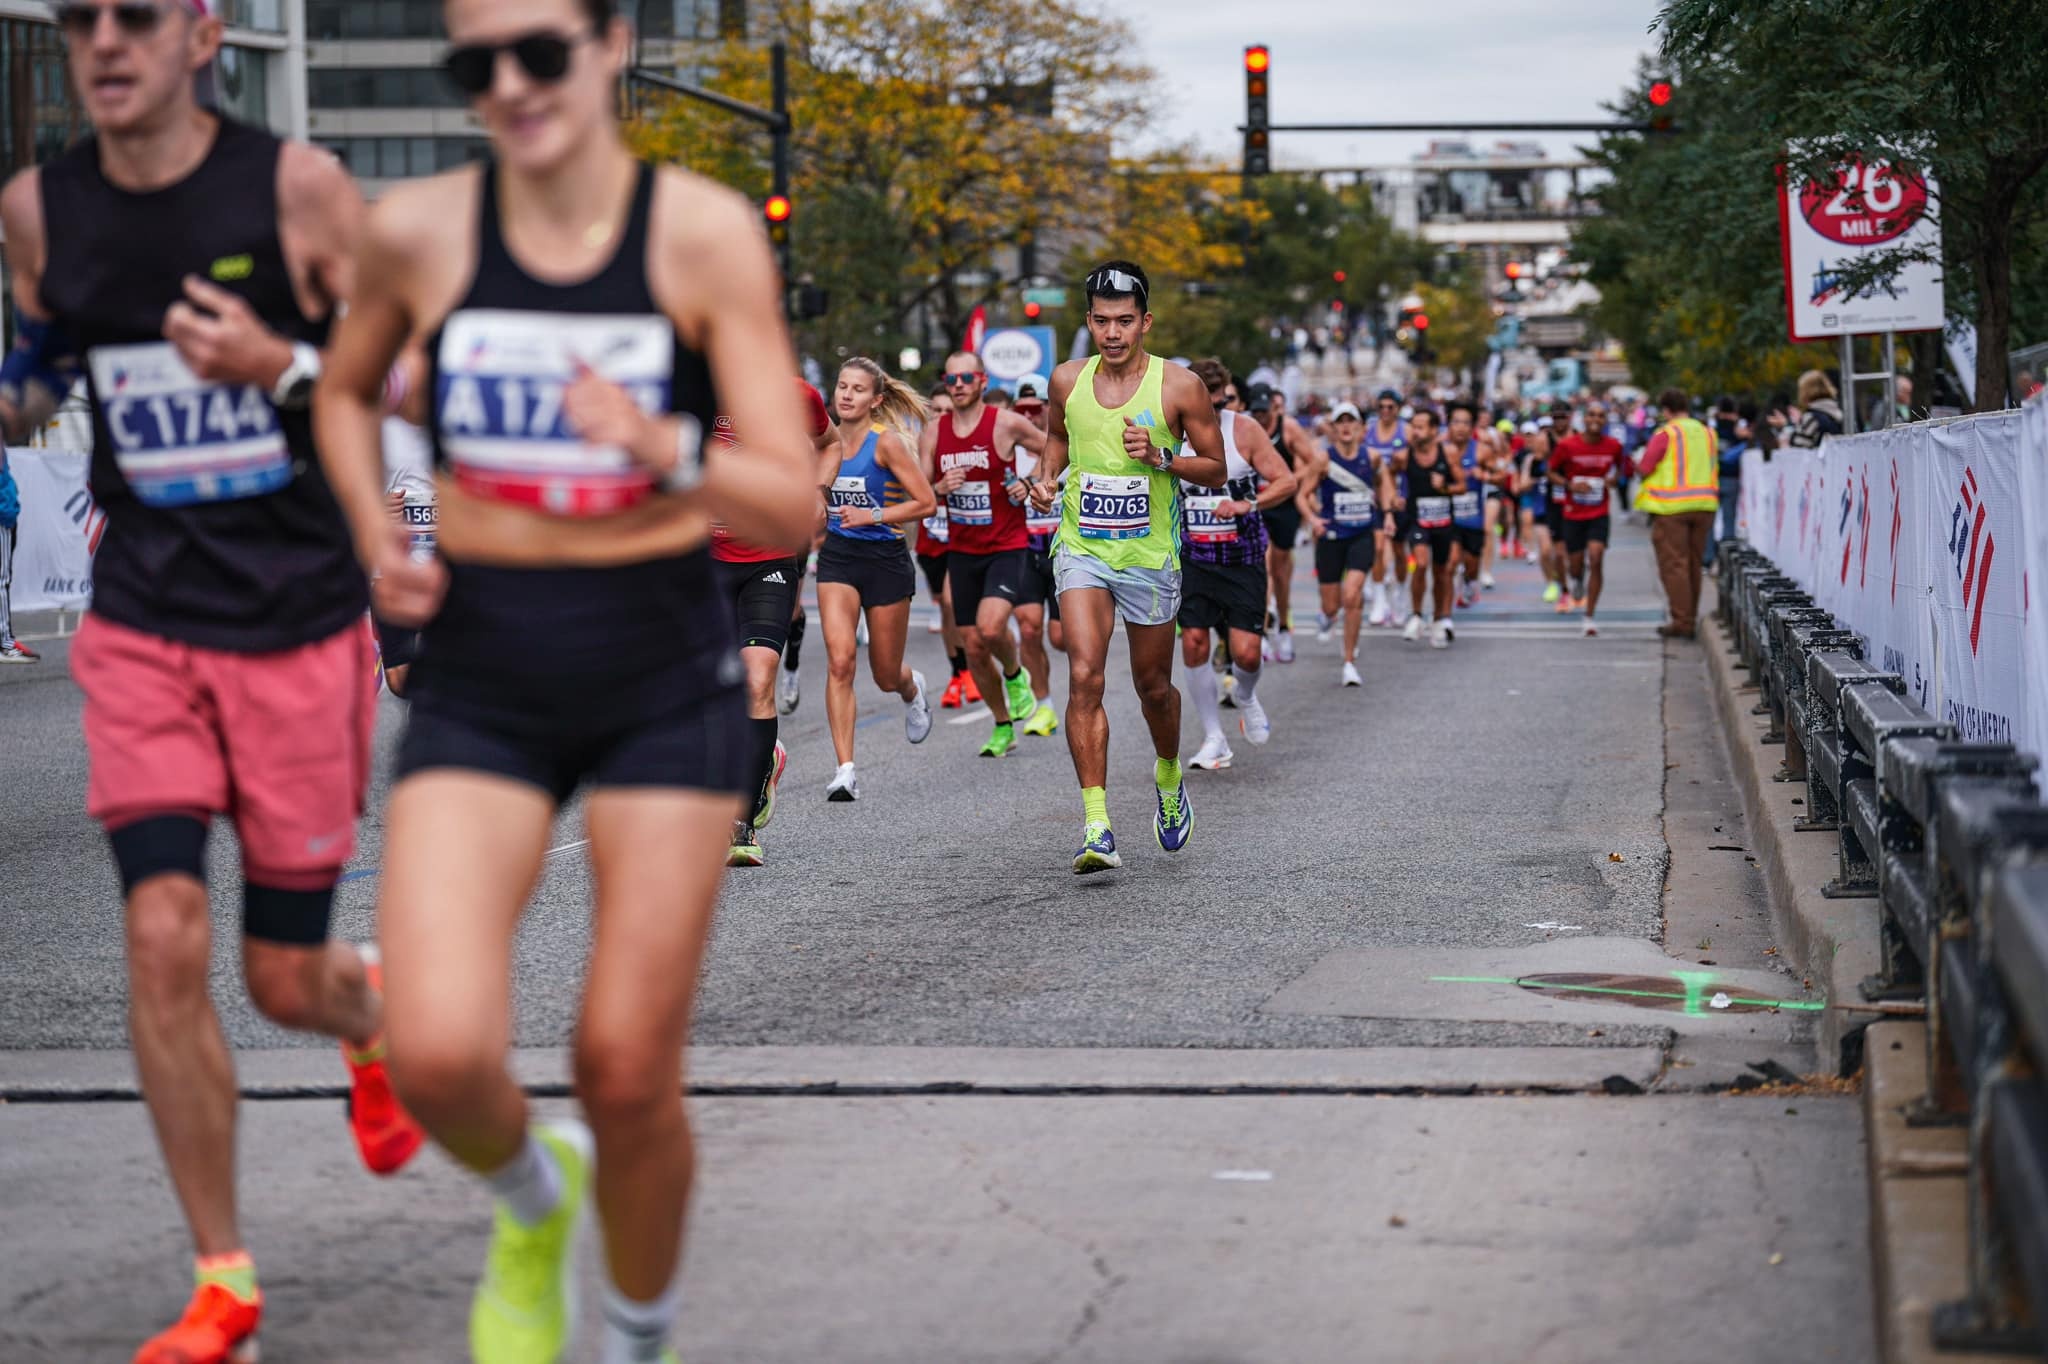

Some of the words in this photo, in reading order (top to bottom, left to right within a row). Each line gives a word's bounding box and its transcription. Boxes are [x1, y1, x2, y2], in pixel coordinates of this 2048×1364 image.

[1825, 158, 1902, 216] 26
[441, 376, 489, 434] A
[107, 398, 142, 449] C
[940, 450, 990, 473] COLUMBUS
[832, 492, 868, 505] 17903
[955, 495, 990, 509] 13619
[1081, 495, 1089, 512] C
[1094, 496, 1147, 515] 20763
[1187, 511, 1195, 523] B
[1977, 709, 2012, 746] AMERICA
